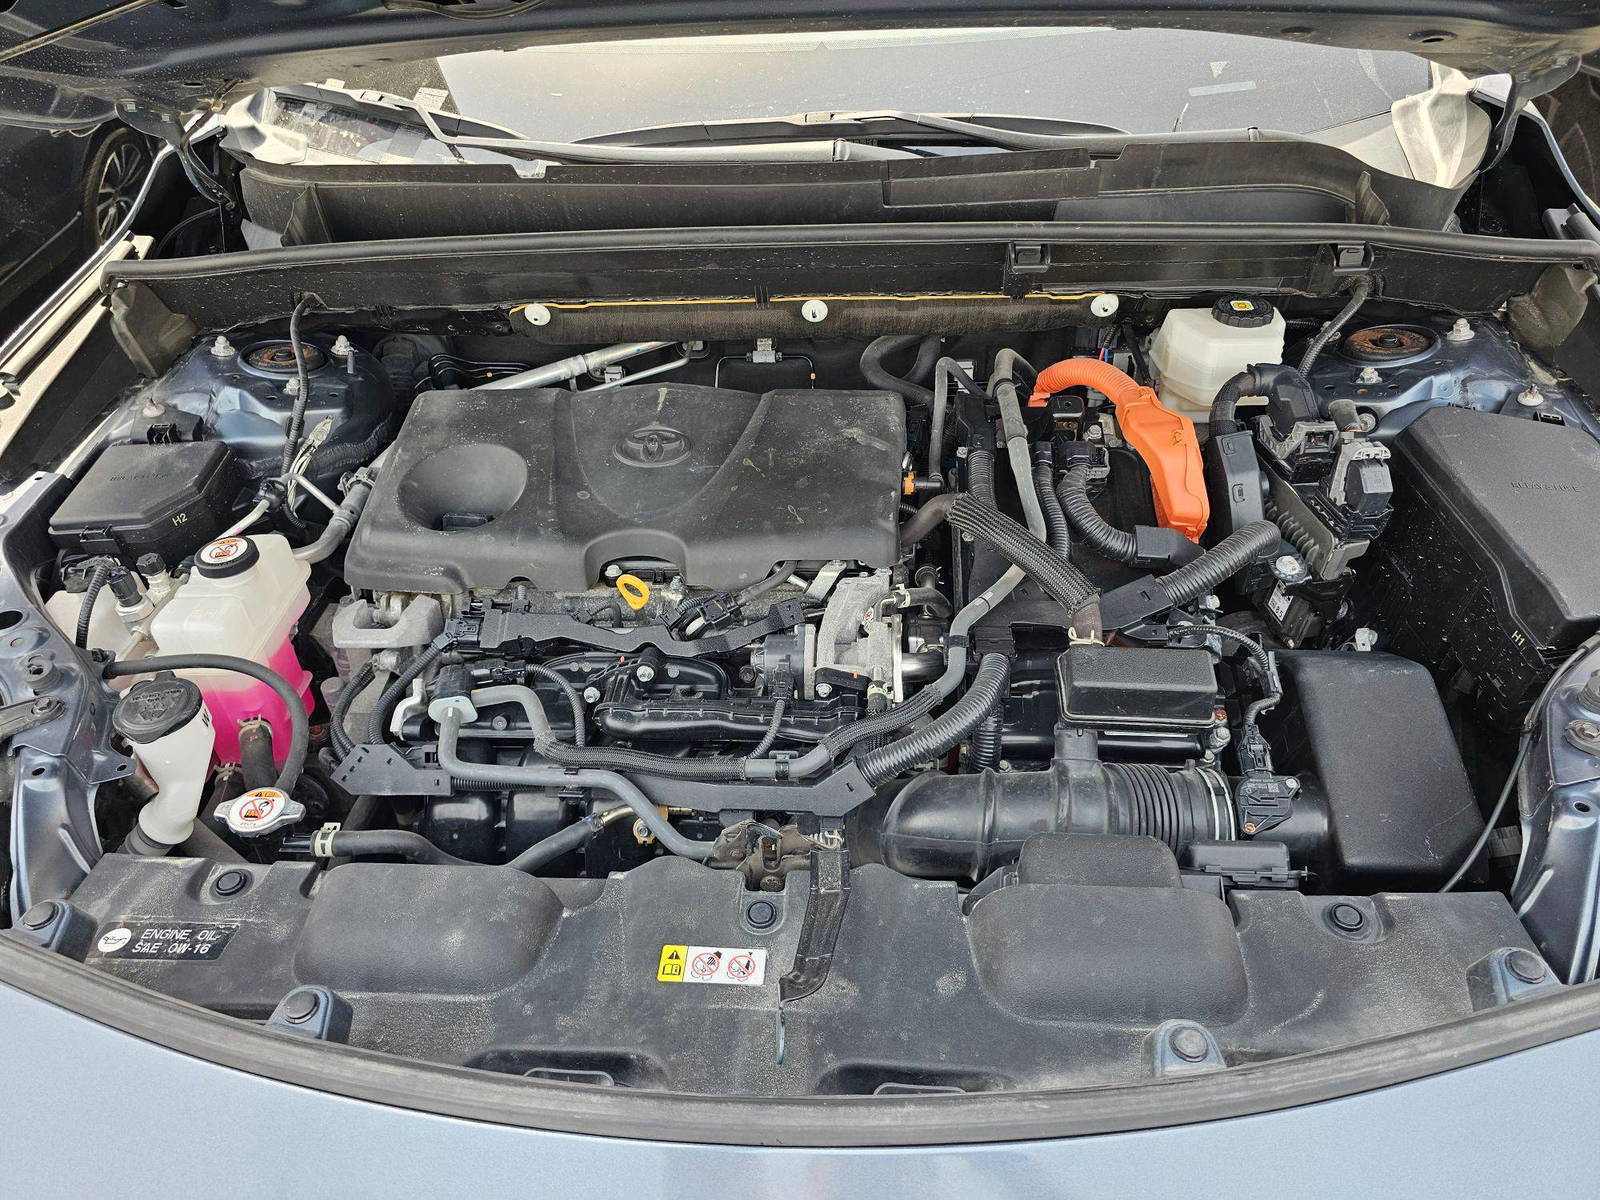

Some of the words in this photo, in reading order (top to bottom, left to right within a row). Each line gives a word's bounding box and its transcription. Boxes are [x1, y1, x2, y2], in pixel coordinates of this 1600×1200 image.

[171, 512, 188, 527] H2
[1511, 630, 1525, 646] H1
[140, 928, 192, 940] ENGINE
[197, 929, 218, 941] OIL
[132, 942, 162, 953] SAE
